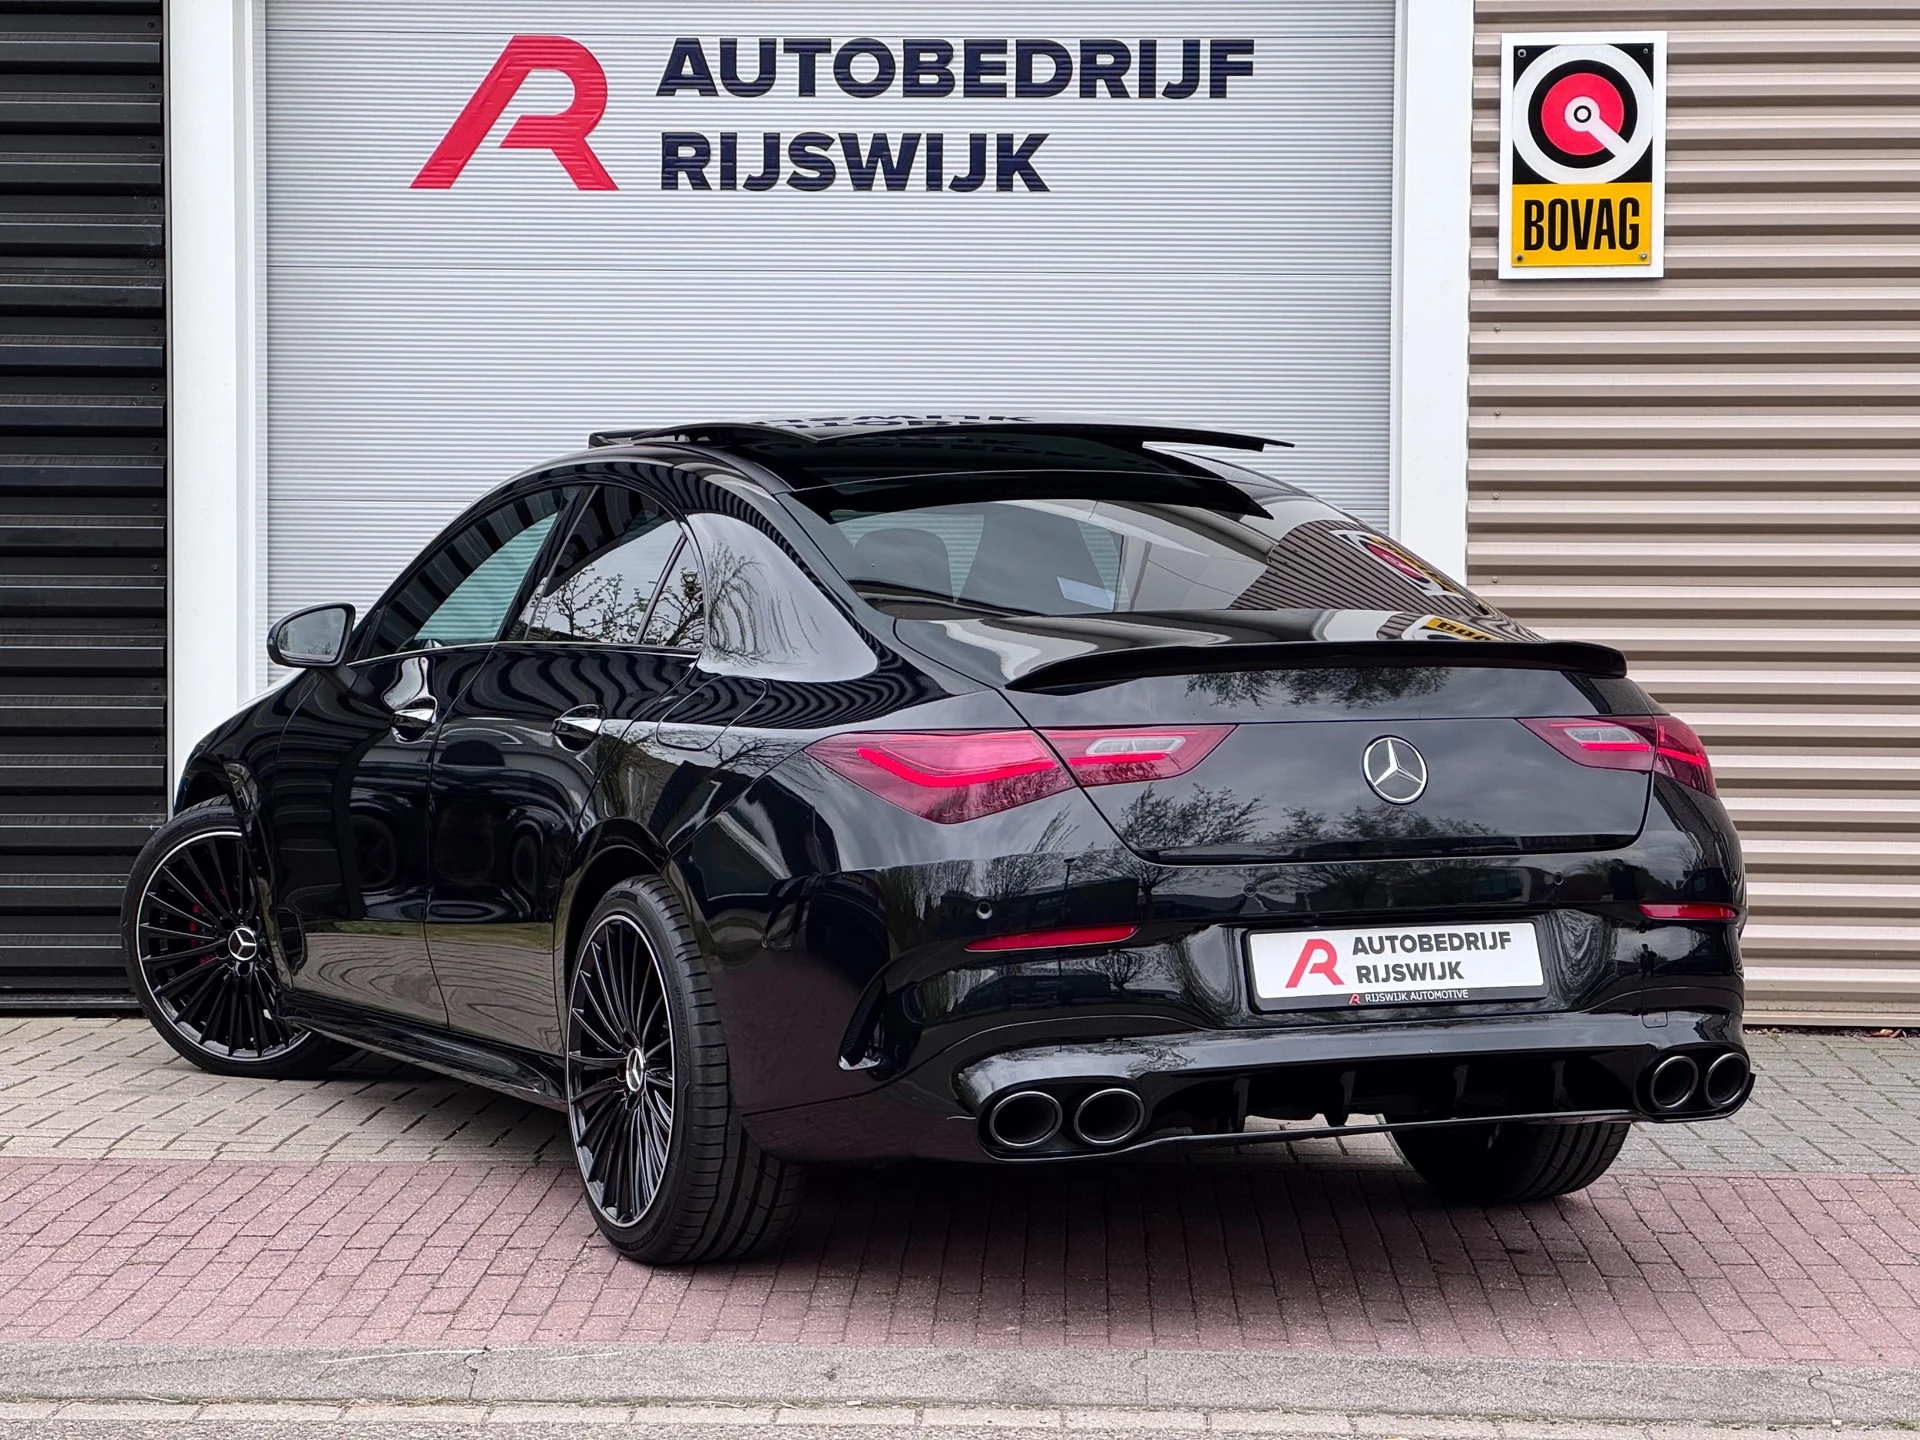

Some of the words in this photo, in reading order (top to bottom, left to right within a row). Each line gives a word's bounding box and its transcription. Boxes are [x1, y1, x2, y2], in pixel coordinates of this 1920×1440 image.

[656, 37, 1255, 100] AUTOBEDRIJF
[660, 132, 1051, 193] RIJSWIJK
[1523, 196, 1640, 252] BOVAG
[1352, 931, 1512, 956] AUTOBEDRIJF
[1356, 961, 1464, 984] RIJSWIJK
[1365, 992, 1408, 1003] RIJSWIJK
[1410, 989, 1469, 1001] AUTOMOTIVE
